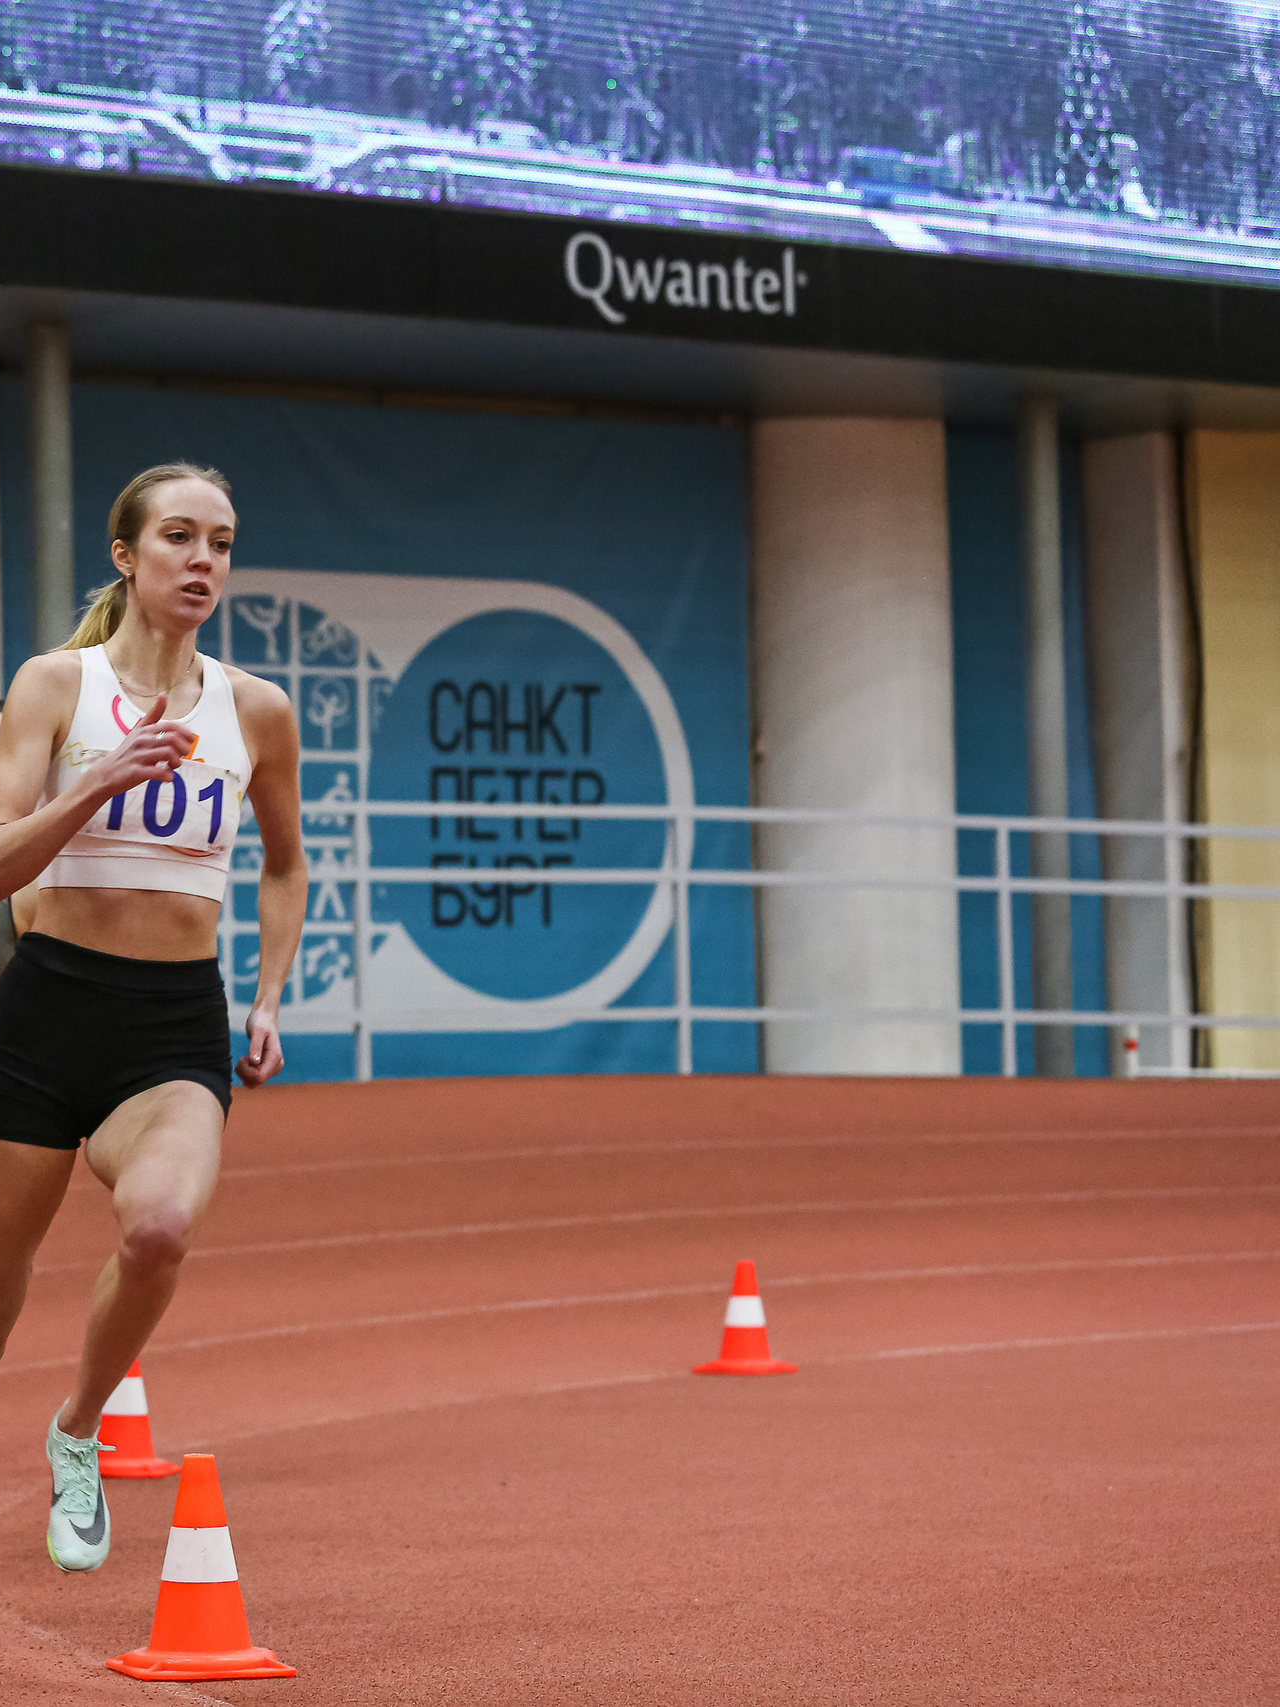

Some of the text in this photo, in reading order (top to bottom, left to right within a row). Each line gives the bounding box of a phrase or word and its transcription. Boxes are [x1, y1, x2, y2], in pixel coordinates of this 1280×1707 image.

[564, 231, 797, 324] Qwantel
[428, 680, 603, 756] САНКТ
[429, 765, 607, 842] ПЕТЕР
[431, 853, 574, 928] БУРГ
